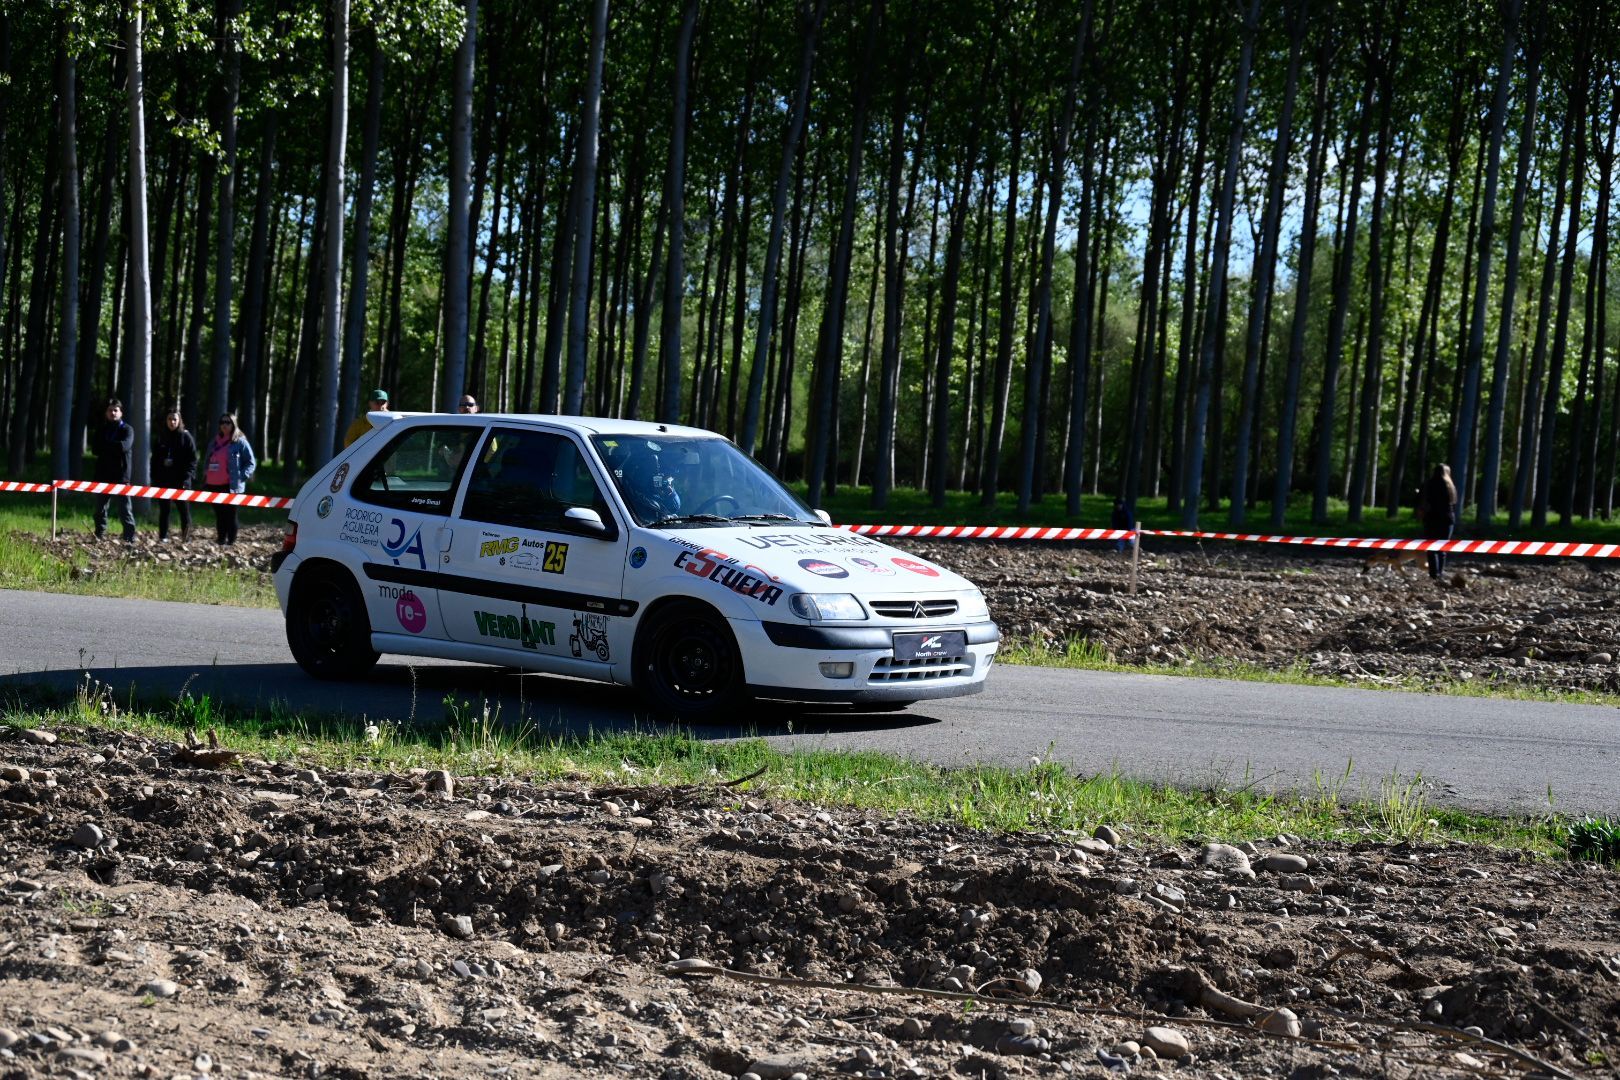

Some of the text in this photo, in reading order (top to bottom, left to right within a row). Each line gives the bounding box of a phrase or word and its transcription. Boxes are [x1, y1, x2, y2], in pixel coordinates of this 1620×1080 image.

[345, 508, 383, 524] RODRIGO
[342, 520, 379, 537] AGUILERA
[480, 536, 545, 558] RMG Autos
[543, 543, 567, 572] 25
[673, 548, 784, 607] ESCUELA
[378, 584, 415, 602] moda
[473, 607, 556, 648] VERDANT
